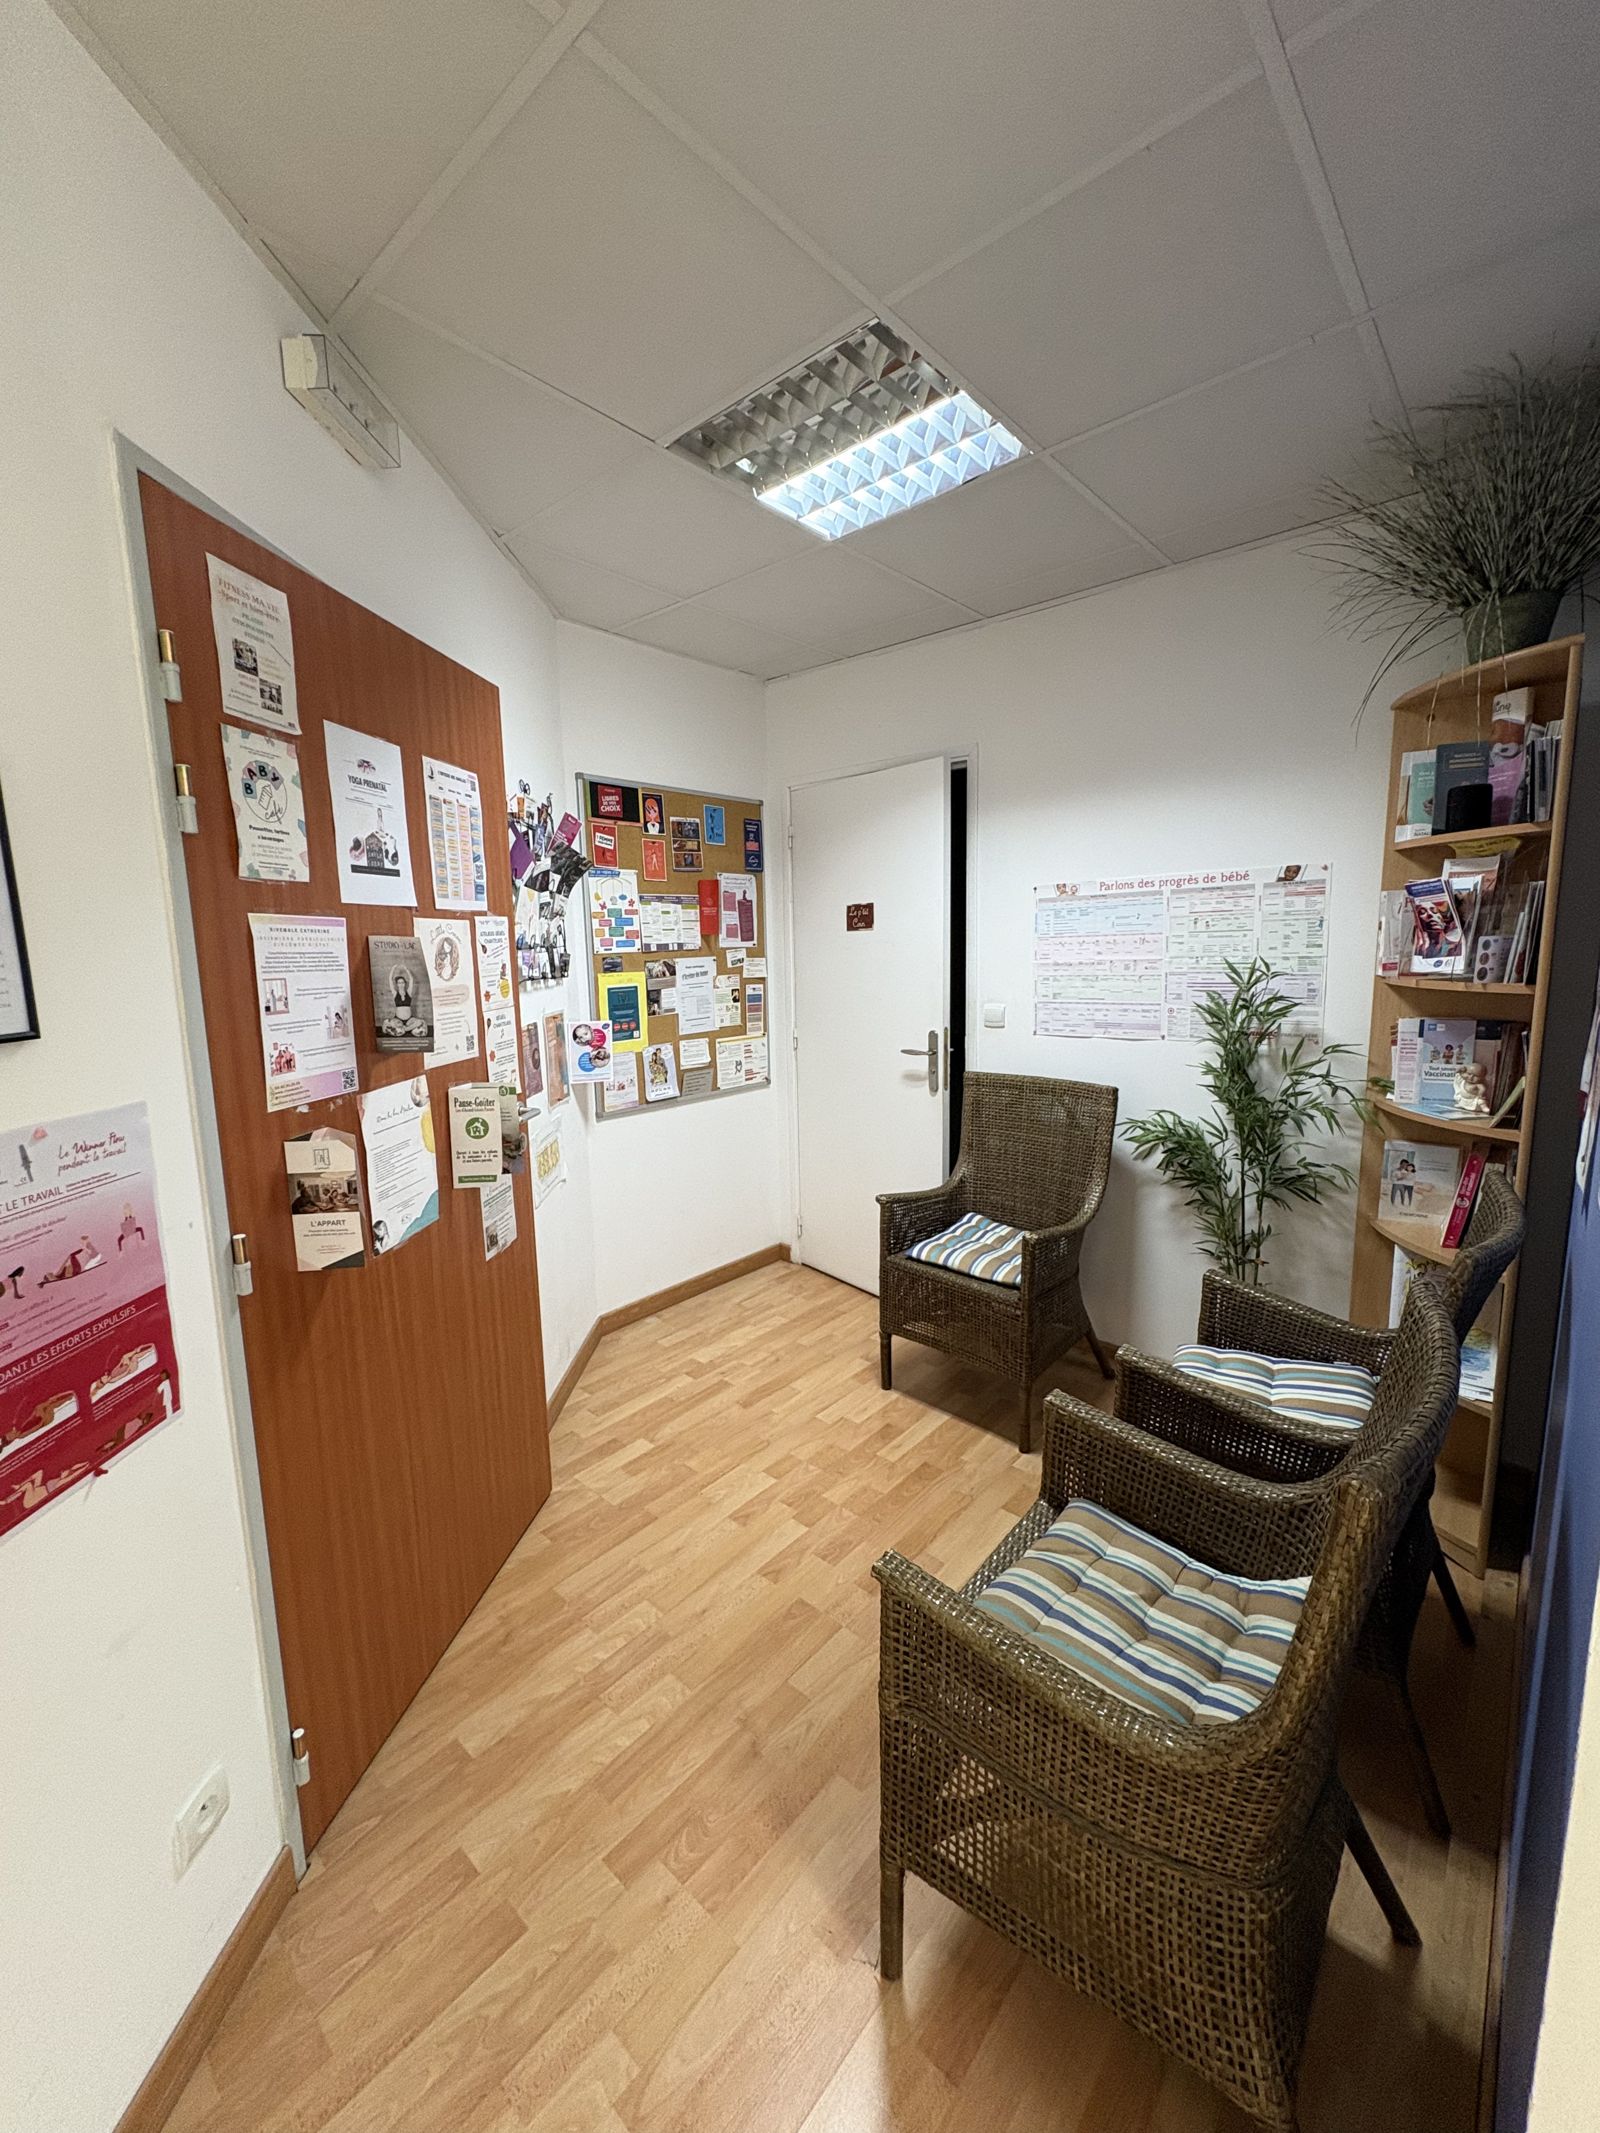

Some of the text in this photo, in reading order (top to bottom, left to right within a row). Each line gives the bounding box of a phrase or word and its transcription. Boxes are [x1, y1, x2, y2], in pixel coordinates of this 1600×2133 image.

[347, 774, 363, 786] YOGA
[1099, 878, 1135, 892] Parlons
[1138, 877, 1156, 889] des
[1159, 875, 1199, 890] progrès
[1202, 874, 1217, 884] de
[1220, 870, 1250, 882] bébé
[454, 1096, 495, 1108] Pause-Goûter
[59, 1131, 125, 1160] Le Winner Flow
[57, 1141, 127, 1176] pendant le travail
[5, 1201, 19, 1212] LE
[20, 1186, 63, 1207] TRAVAIL
[310, 1219, 346, 1228] L'APPART
[30, 1350, 49, 1367] LES
[50, 1329, 92, 1357] EFFORTS
[92, 1304, 137, 1334] EXPULSIFS
